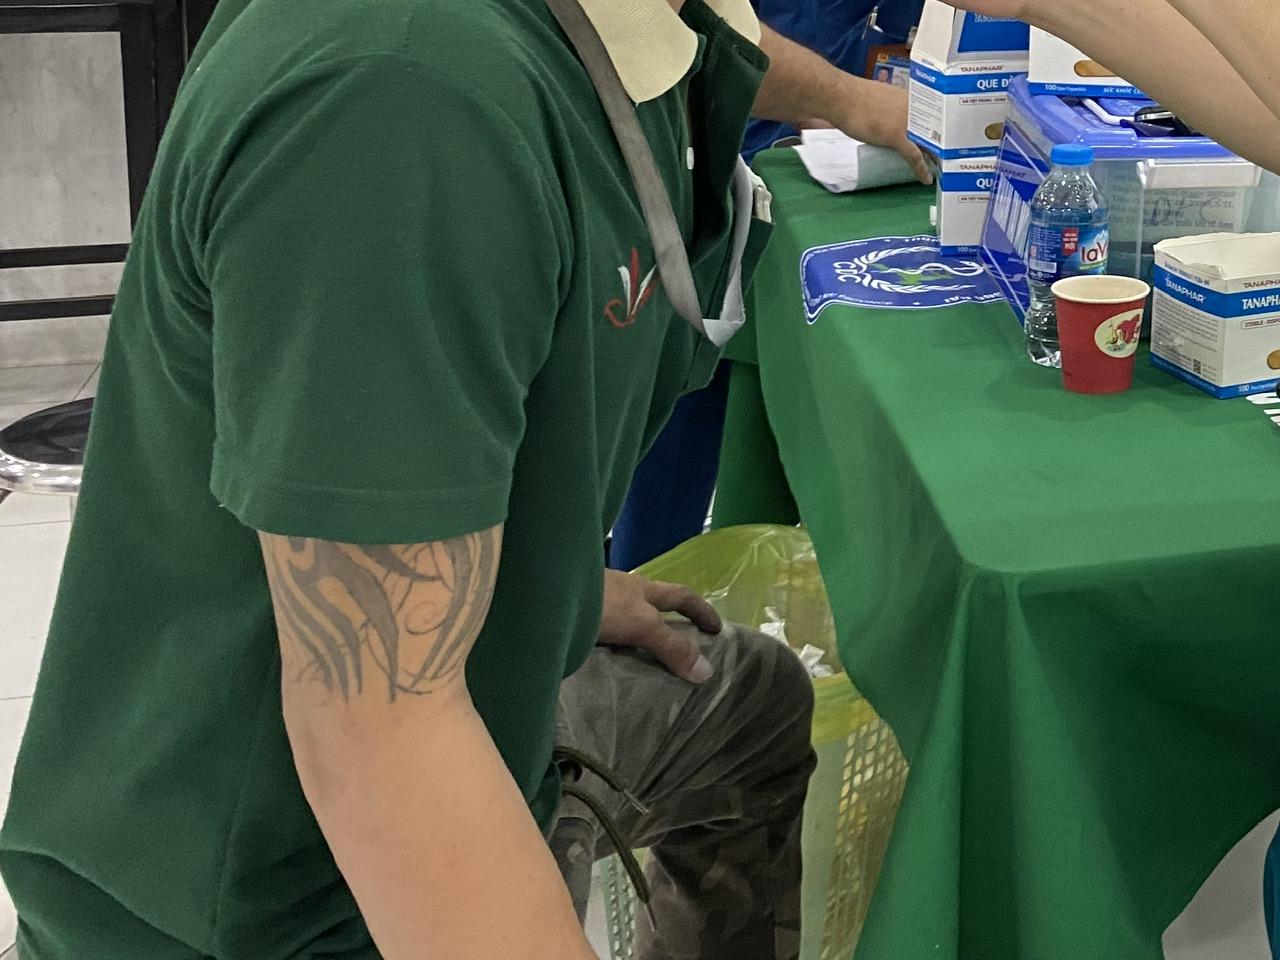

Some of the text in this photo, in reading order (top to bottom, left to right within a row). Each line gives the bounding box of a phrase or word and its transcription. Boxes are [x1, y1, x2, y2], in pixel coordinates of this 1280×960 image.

[976, 78, 998, 91] QUE
[1045, 83, 1057, 91] 100
[976, 177, 994, 189] QU
[832, 261, 862, 284] CDC
[1164, 276, 1205, 304] TANAPHAR
[1238, 384, 1250, 393] 100
